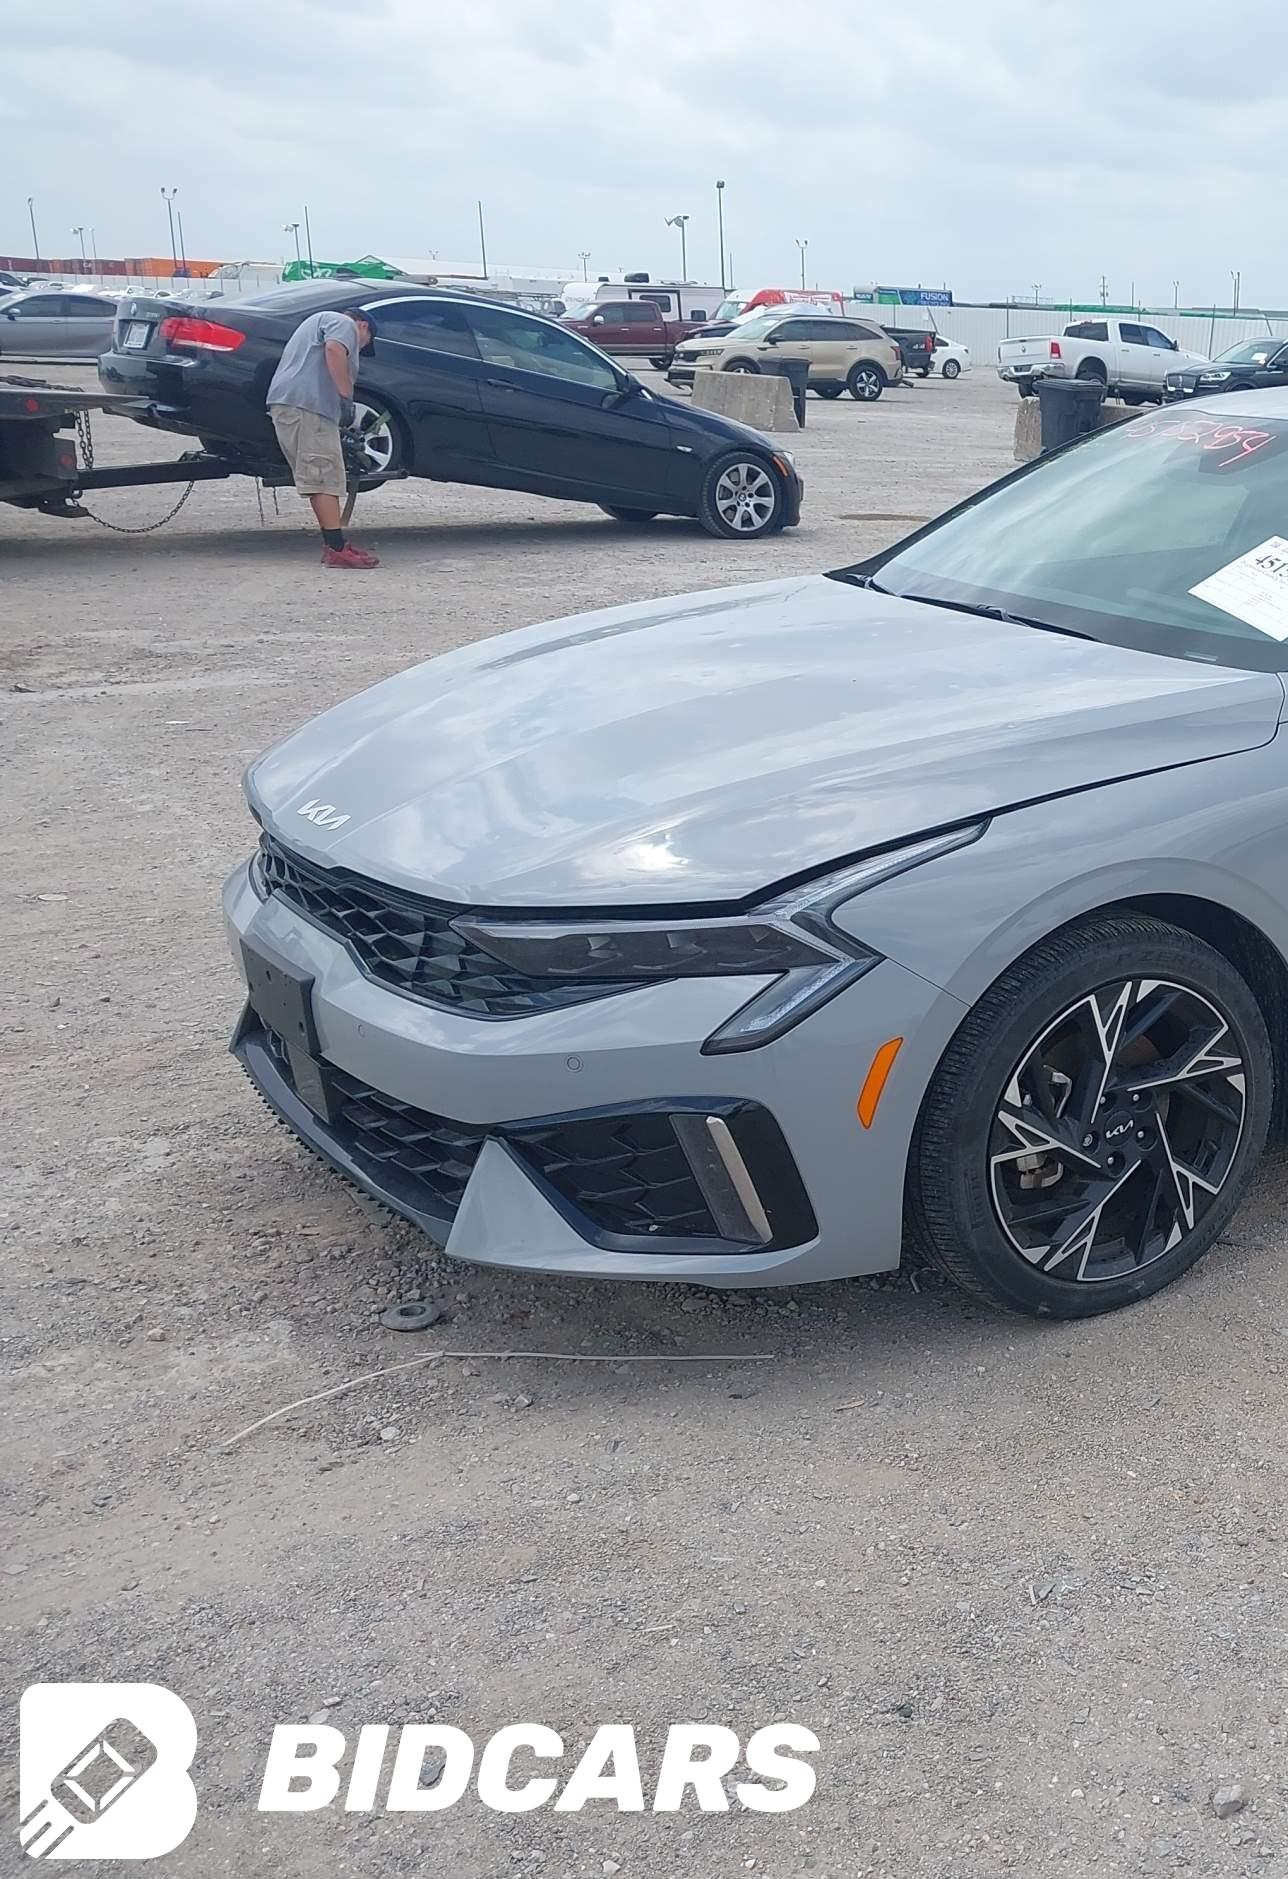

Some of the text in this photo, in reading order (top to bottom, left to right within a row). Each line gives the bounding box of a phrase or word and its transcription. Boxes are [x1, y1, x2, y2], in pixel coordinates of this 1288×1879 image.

[920, 292, 949, 301] FUSION
[296, 798, 352, 831] KIA
[1105, 1119, 1134, 1139] KIA
